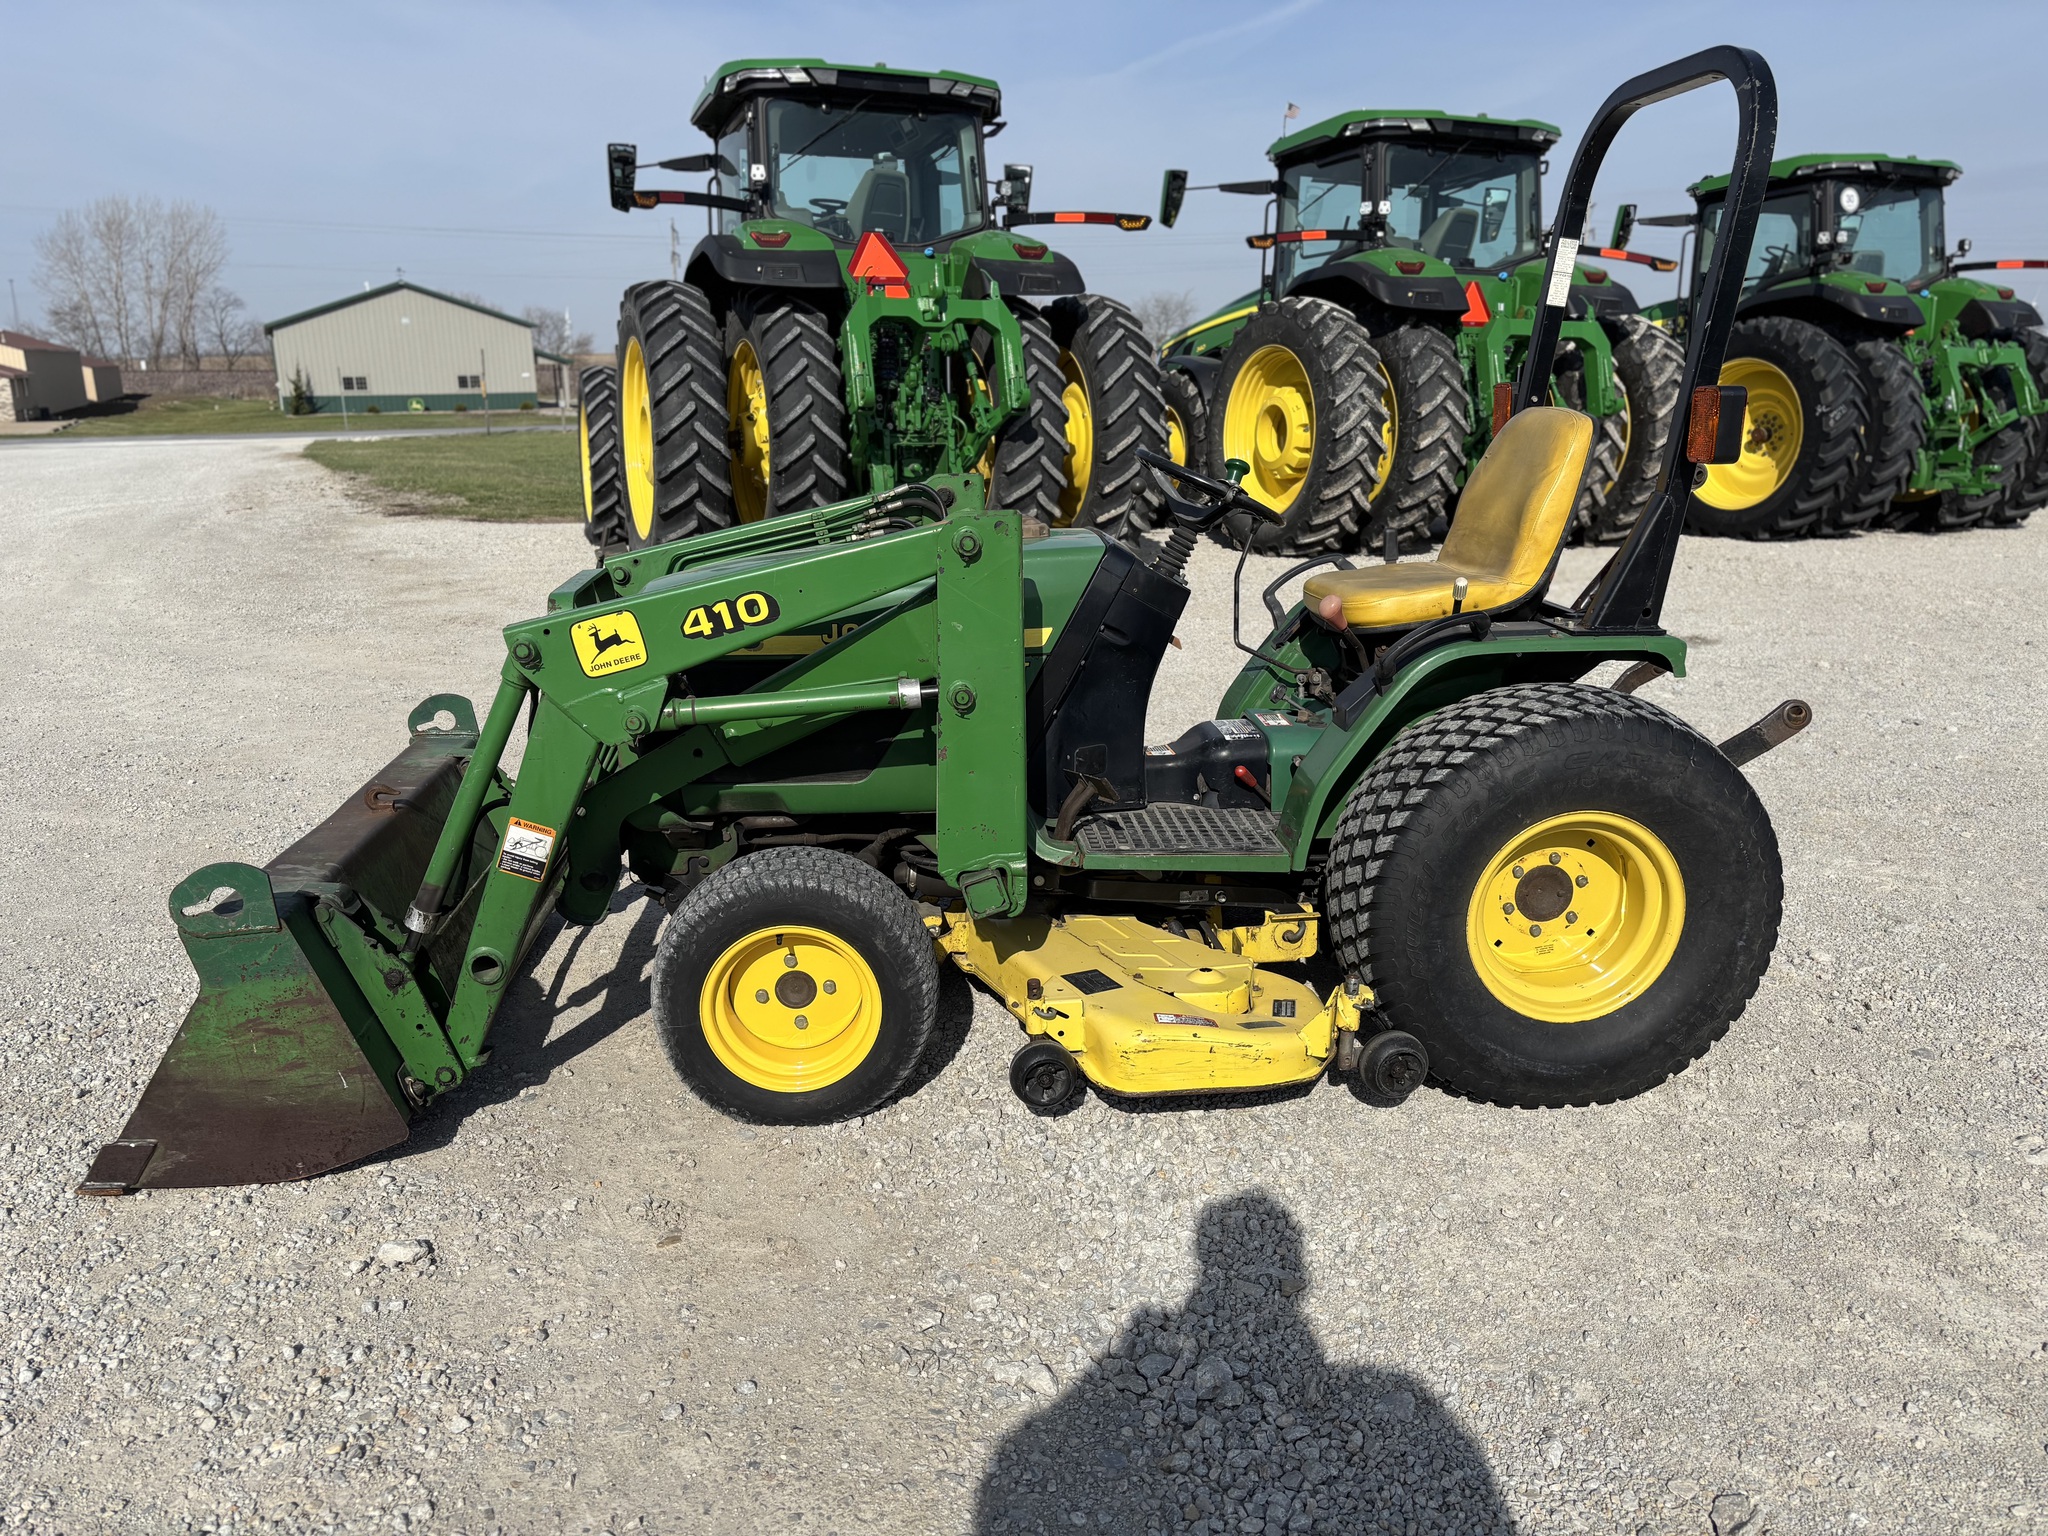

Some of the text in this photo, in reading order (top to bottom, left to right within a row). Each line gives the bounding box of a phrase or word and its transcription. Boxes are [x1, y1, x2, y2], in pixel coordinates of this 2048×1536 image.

[682, 592, 773, 638] 410
[590, 653, 641, 672] JOHN DEERE
[523, 821, 552, 835] WARNING
